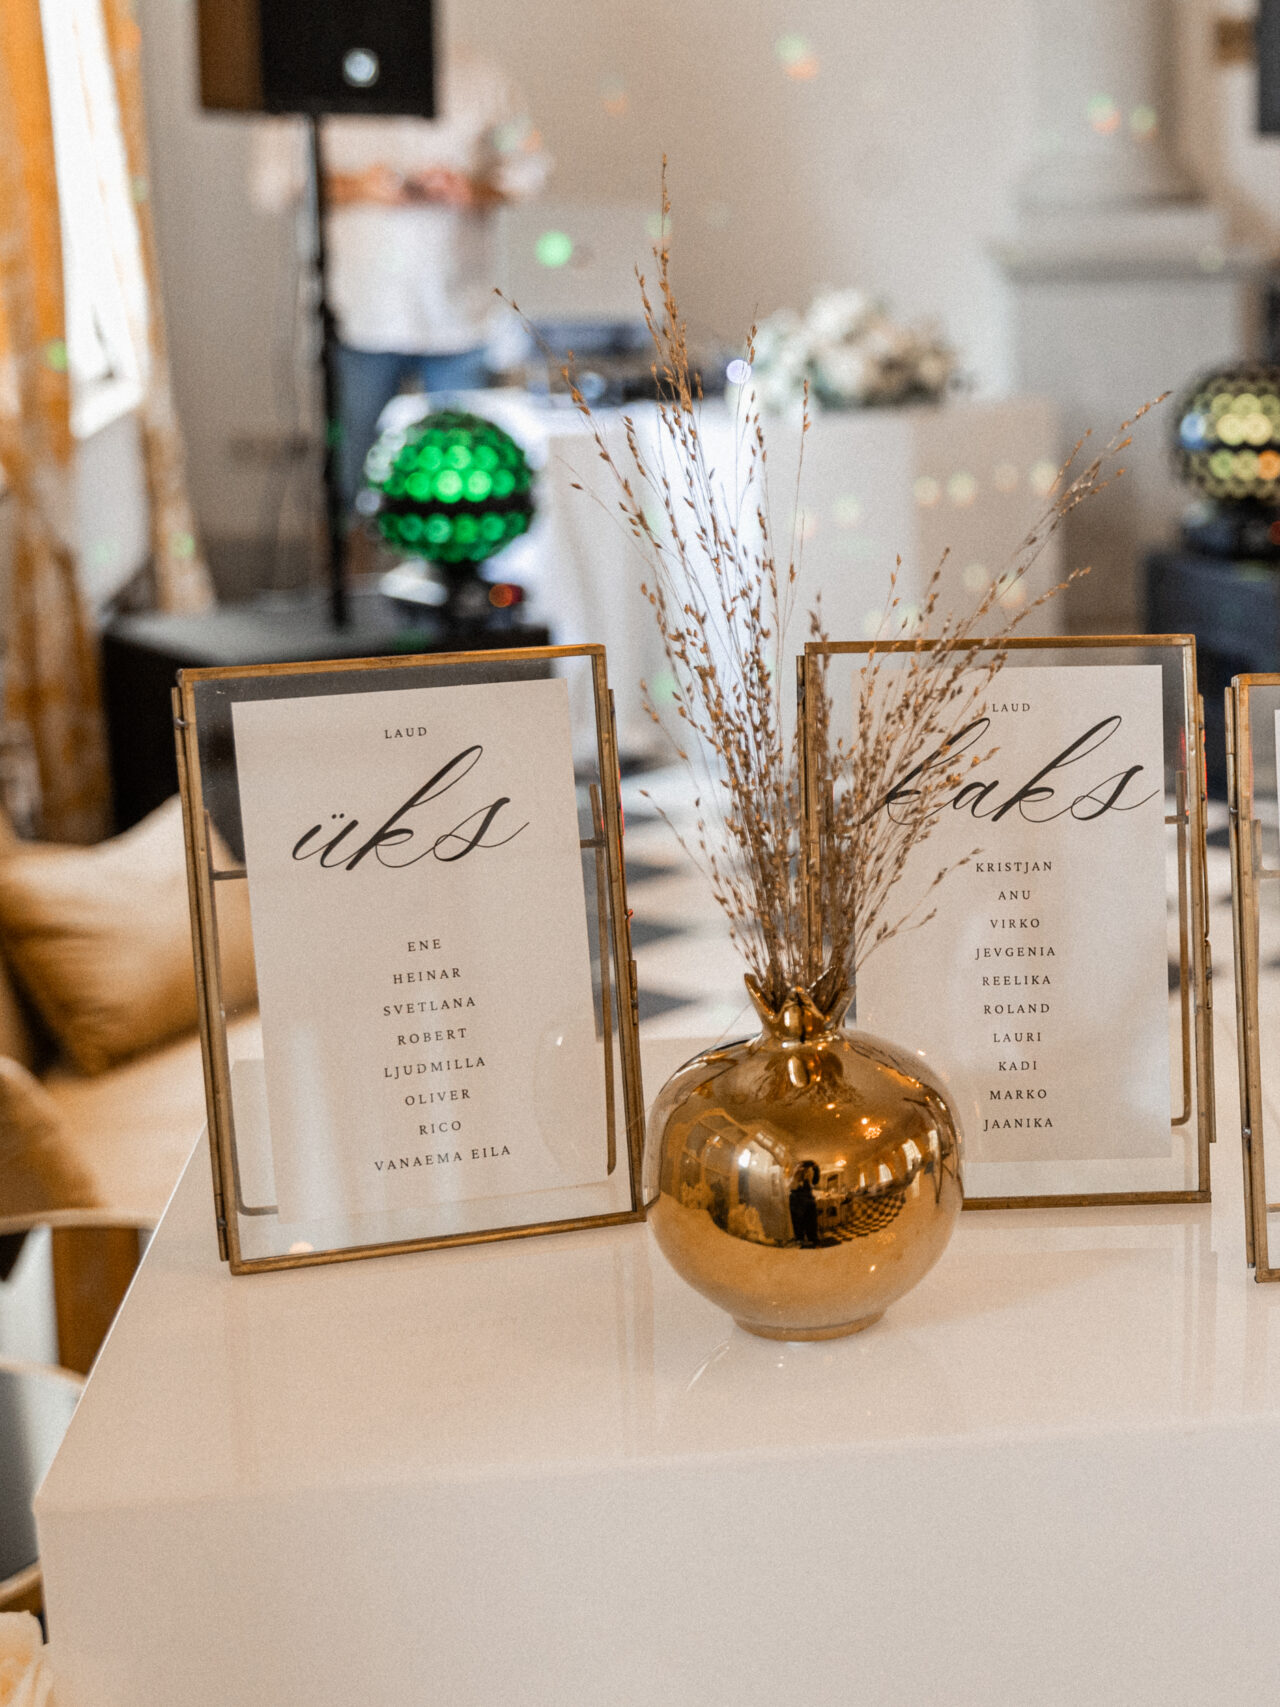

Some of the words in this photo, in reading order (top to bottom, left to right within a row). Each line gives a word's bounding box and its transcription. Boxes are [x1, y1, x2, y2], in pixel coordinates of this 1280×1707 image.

[992, 703, 1031, 713] LAUD
[384, 727, 428, 740] LAUD
[860, 715, 1161, 826] kaks
[292, 744, 531, 872] üks
[976, 861, 1053, 875] KRISTJAN
[998, 890, 1031, 901] ANU
[990, 918, 1041, 929] VIRKO
[407, 939, 442, 953] ENE
[975, 947, 1056, 961] JEVGENIA
[393, 968, 461, 985] HEINAR
[982, 975, 1051, 987] REELIKA
[383, 997, 476, 1017] SVETLANA
[984, 1003, 1051, 1015] ROLAND
[397, 1028, 467, 1046] ROBERT
[993, 1032, 1042, 1044] LAURI
[384, 1057, 486, 1081] LJUDMILLA
[999, 1061, 1038, 1072] KADI
[404, 1089, 471, 1107] OLIVER
[990, 1089, 1048, 1101] MARKO
[419, 1121, 462, 1136] RICO
[983, 1118, 1054, 1133] JAANIKA
[374, 1152, 463, 1172] VANAEMA
[471, 1146, 511, 1160] EILA
